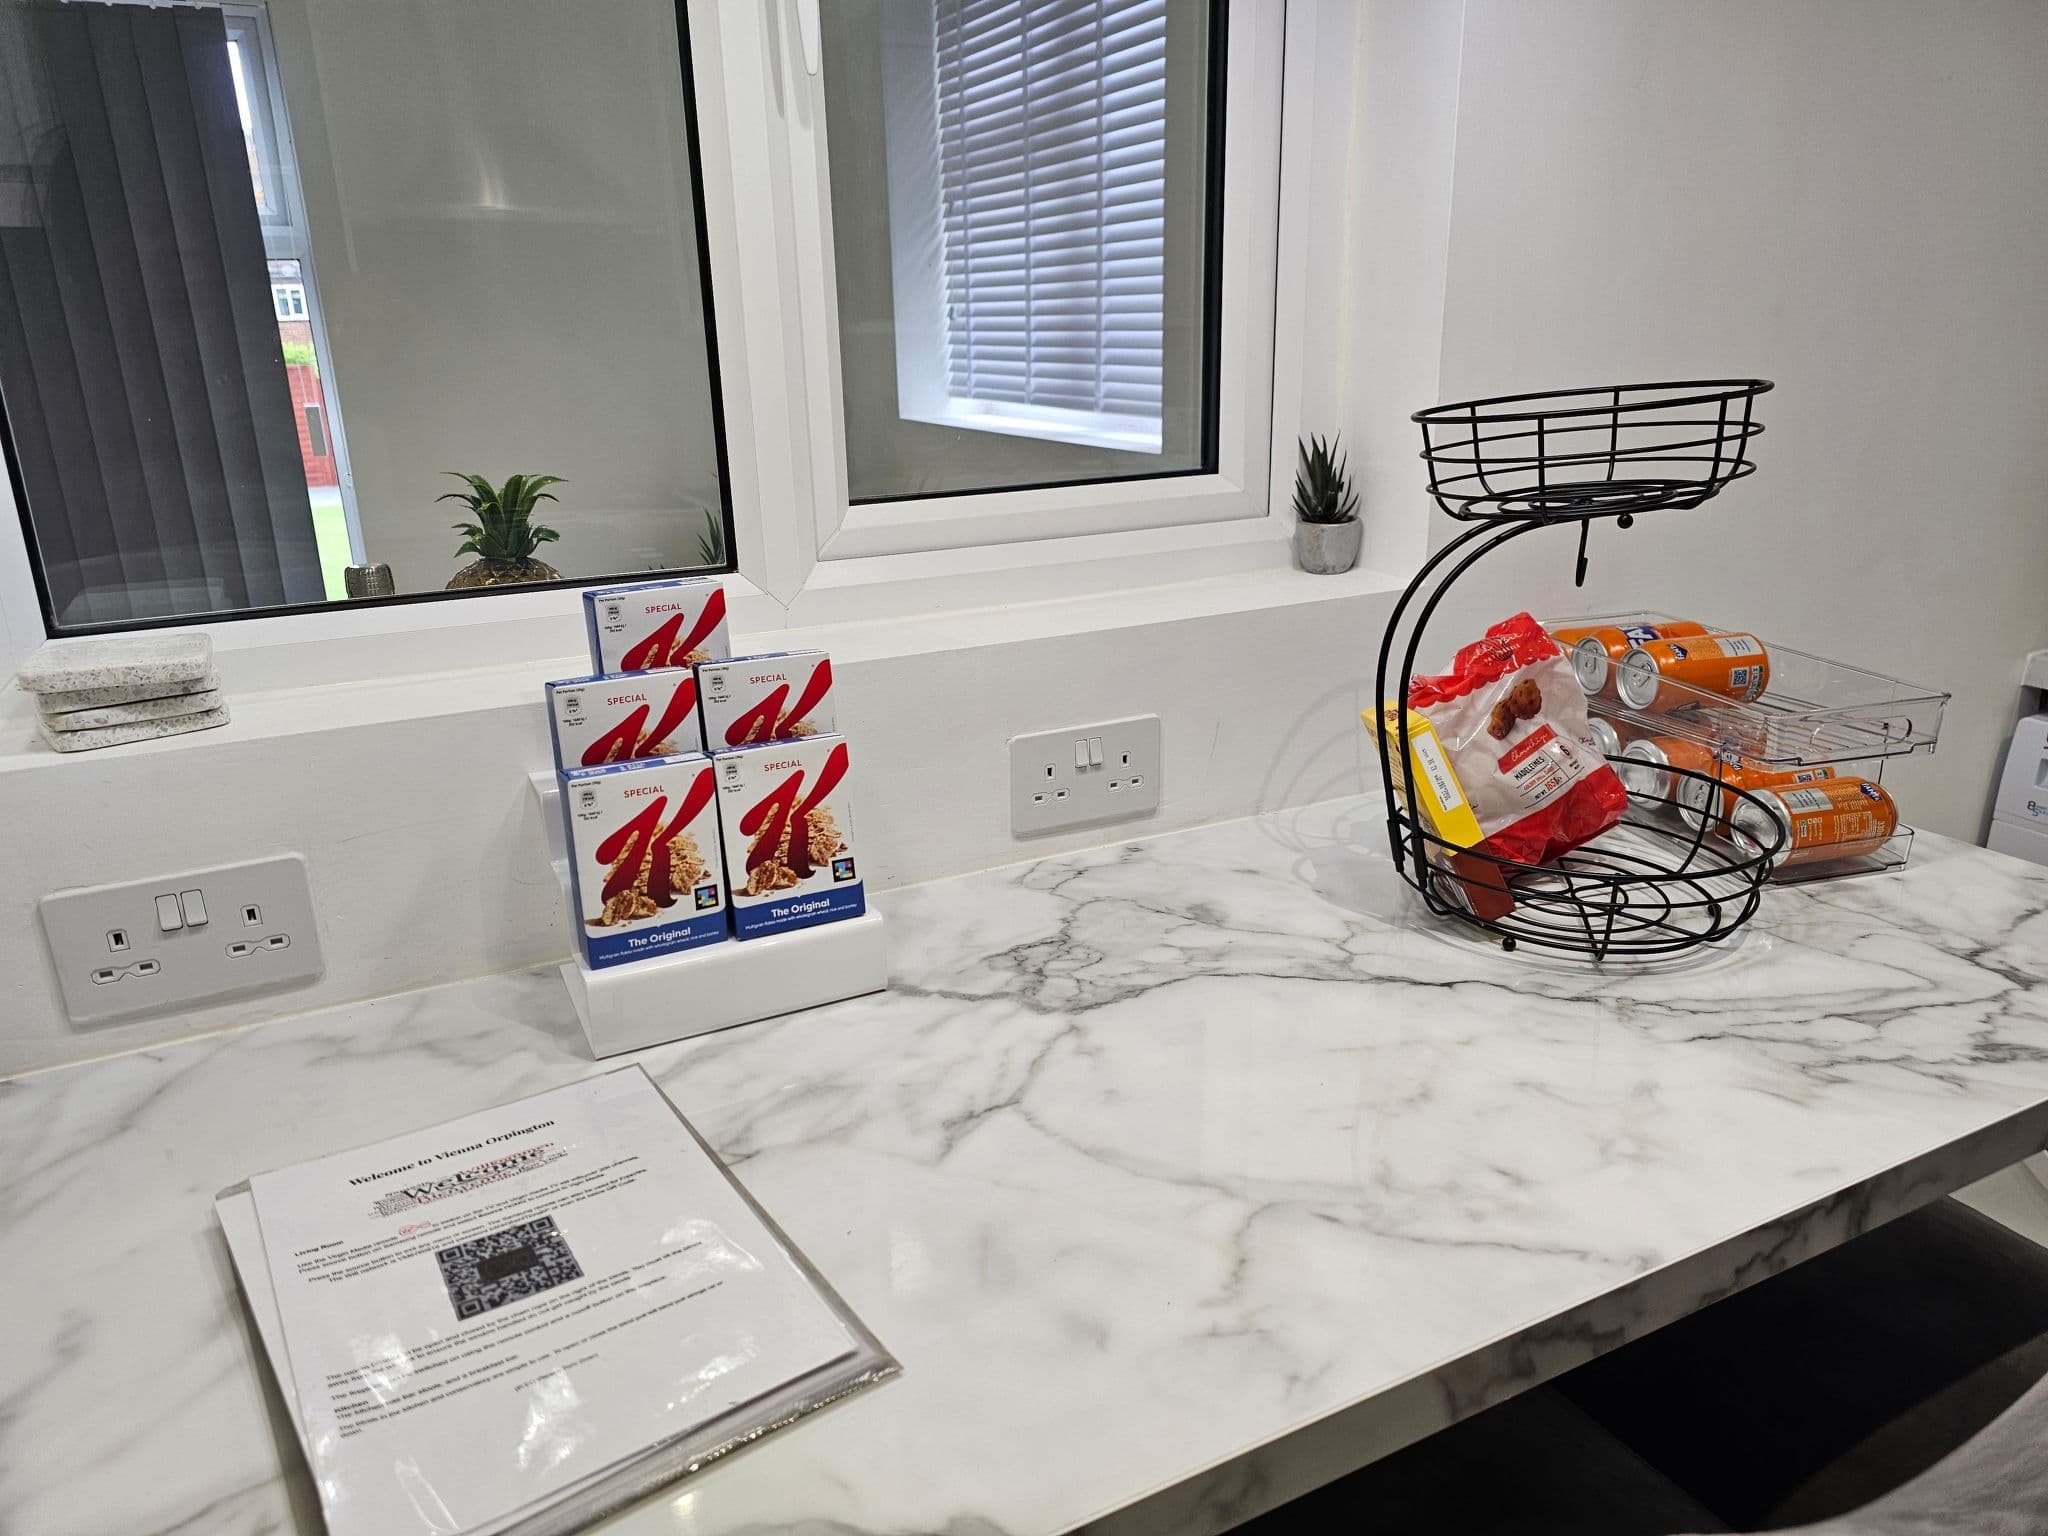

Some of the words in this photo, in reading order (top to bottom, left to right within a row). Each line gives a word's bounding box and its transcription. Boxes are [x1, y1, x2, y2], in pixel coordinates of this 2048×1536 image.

[645, 603, 682, 614] SPECIAL
[749, 673, 787, 685] SPECIAL
[607, 693, 647, 706] SPECIAL
[1560, 744, 1570, 756] 6
[764, 760, 802, 772] SPECIAL
[1513, 756, 1545, 781] MADELEINES
[624, 784, 665, 798] SPECIAL
[771, 906, 790, 919] The
[791, 898, 830, 915] Original
[628, 937, 648, 948] The
[650, 926, 691, 946] Original
[348, 1160, 415, 1187] Welcome
[416, 1156, 432, 1166] to
[433, 1140, 483, 1161] Vienna
[484, 1118, 556, 1146] Orpington
